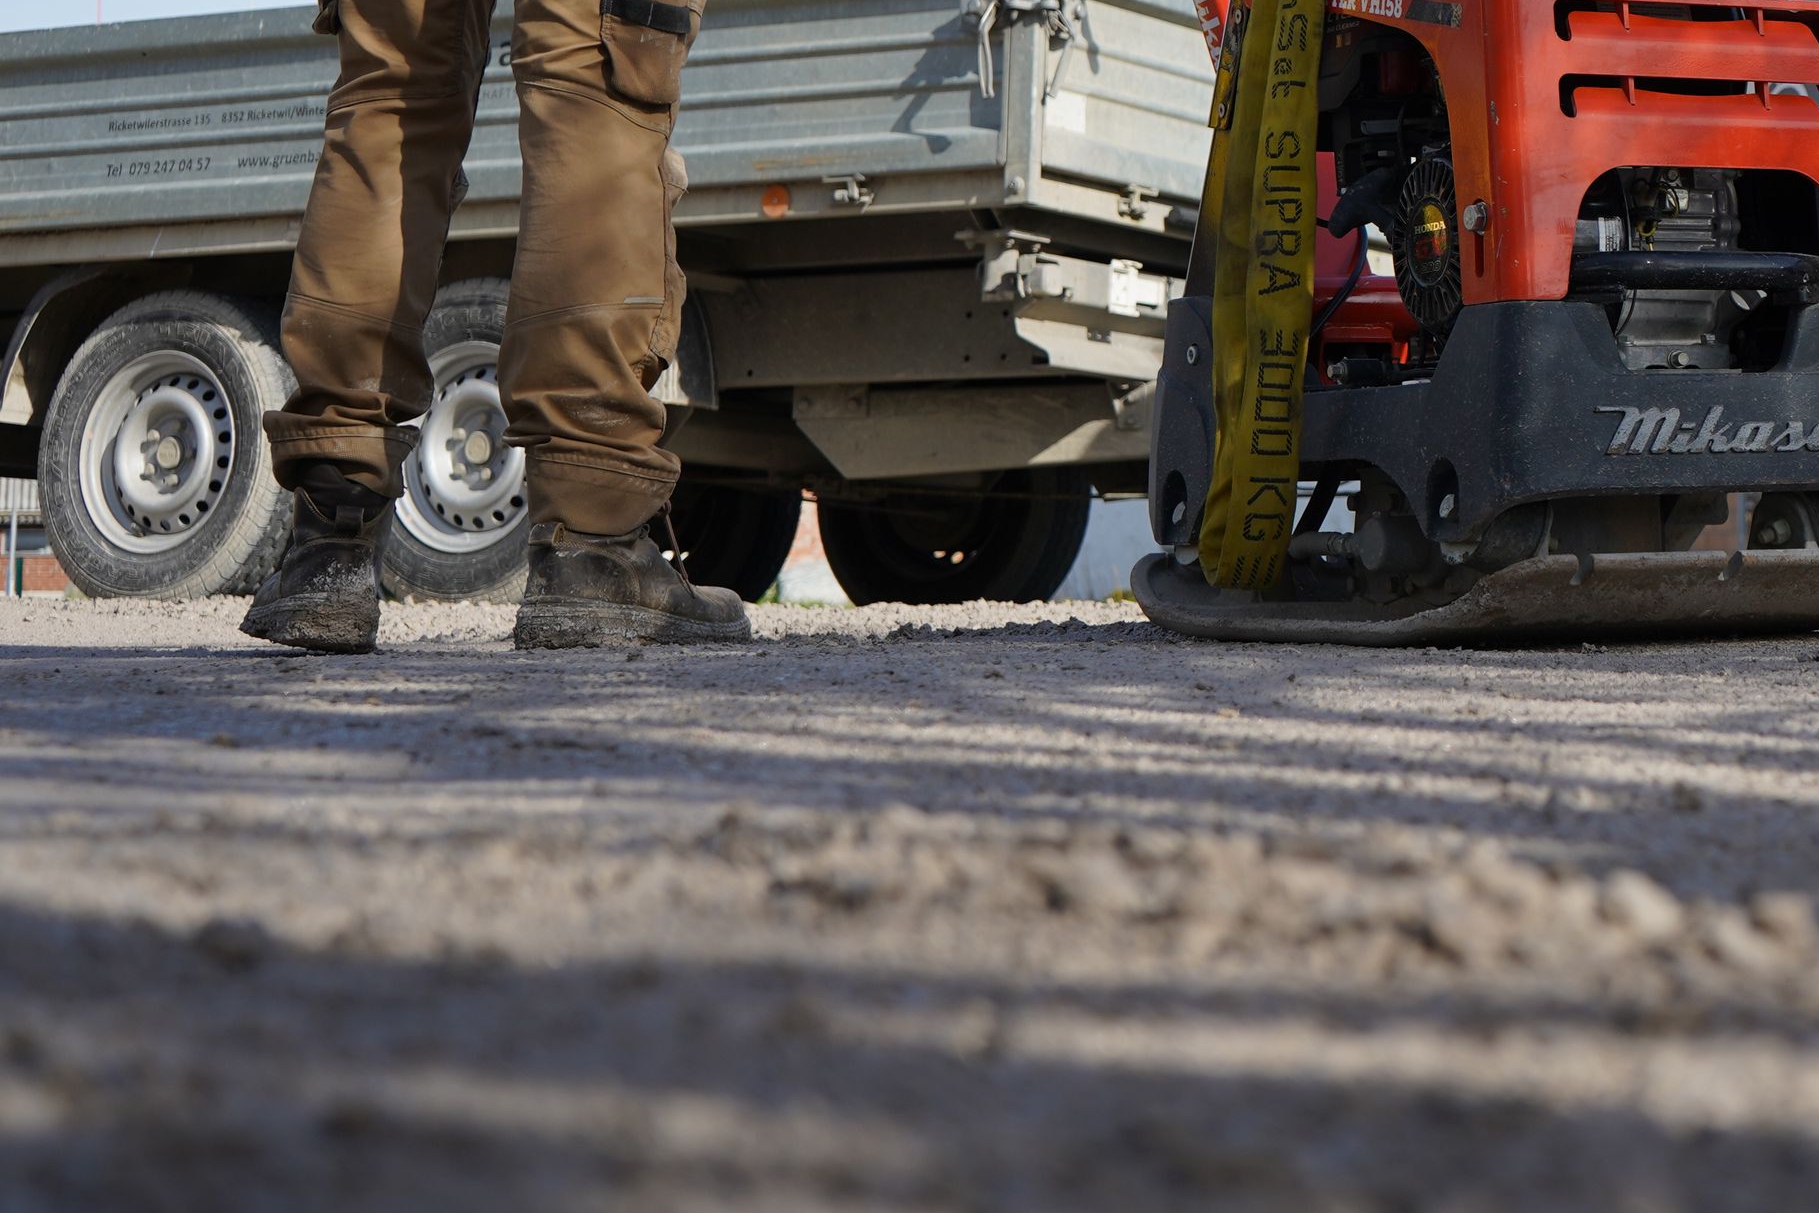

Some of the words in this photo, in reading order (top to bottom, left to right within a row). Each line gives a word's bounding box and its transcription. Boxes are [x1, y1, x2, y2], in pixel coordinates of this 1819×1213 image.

[108, 116, 192, 133] Ricketwilerstrasse
[195, 113, 212, 126] 135
[221, 109, 245, 123] 8352
[107, 162, 123, 178] Tel
[129, 161, 151, 176] 079
[153, 159, 176, 174] 247
[178, 157, 193, 172] 04
[197, 156, 211, 171] 57
[1257, 130, 1303, 296] SUPRA
[1414, 220, 1447, 235] HONDA
[1250, 328, 1300, 457] 3000
[1242, 475, 1291, 542] KG
